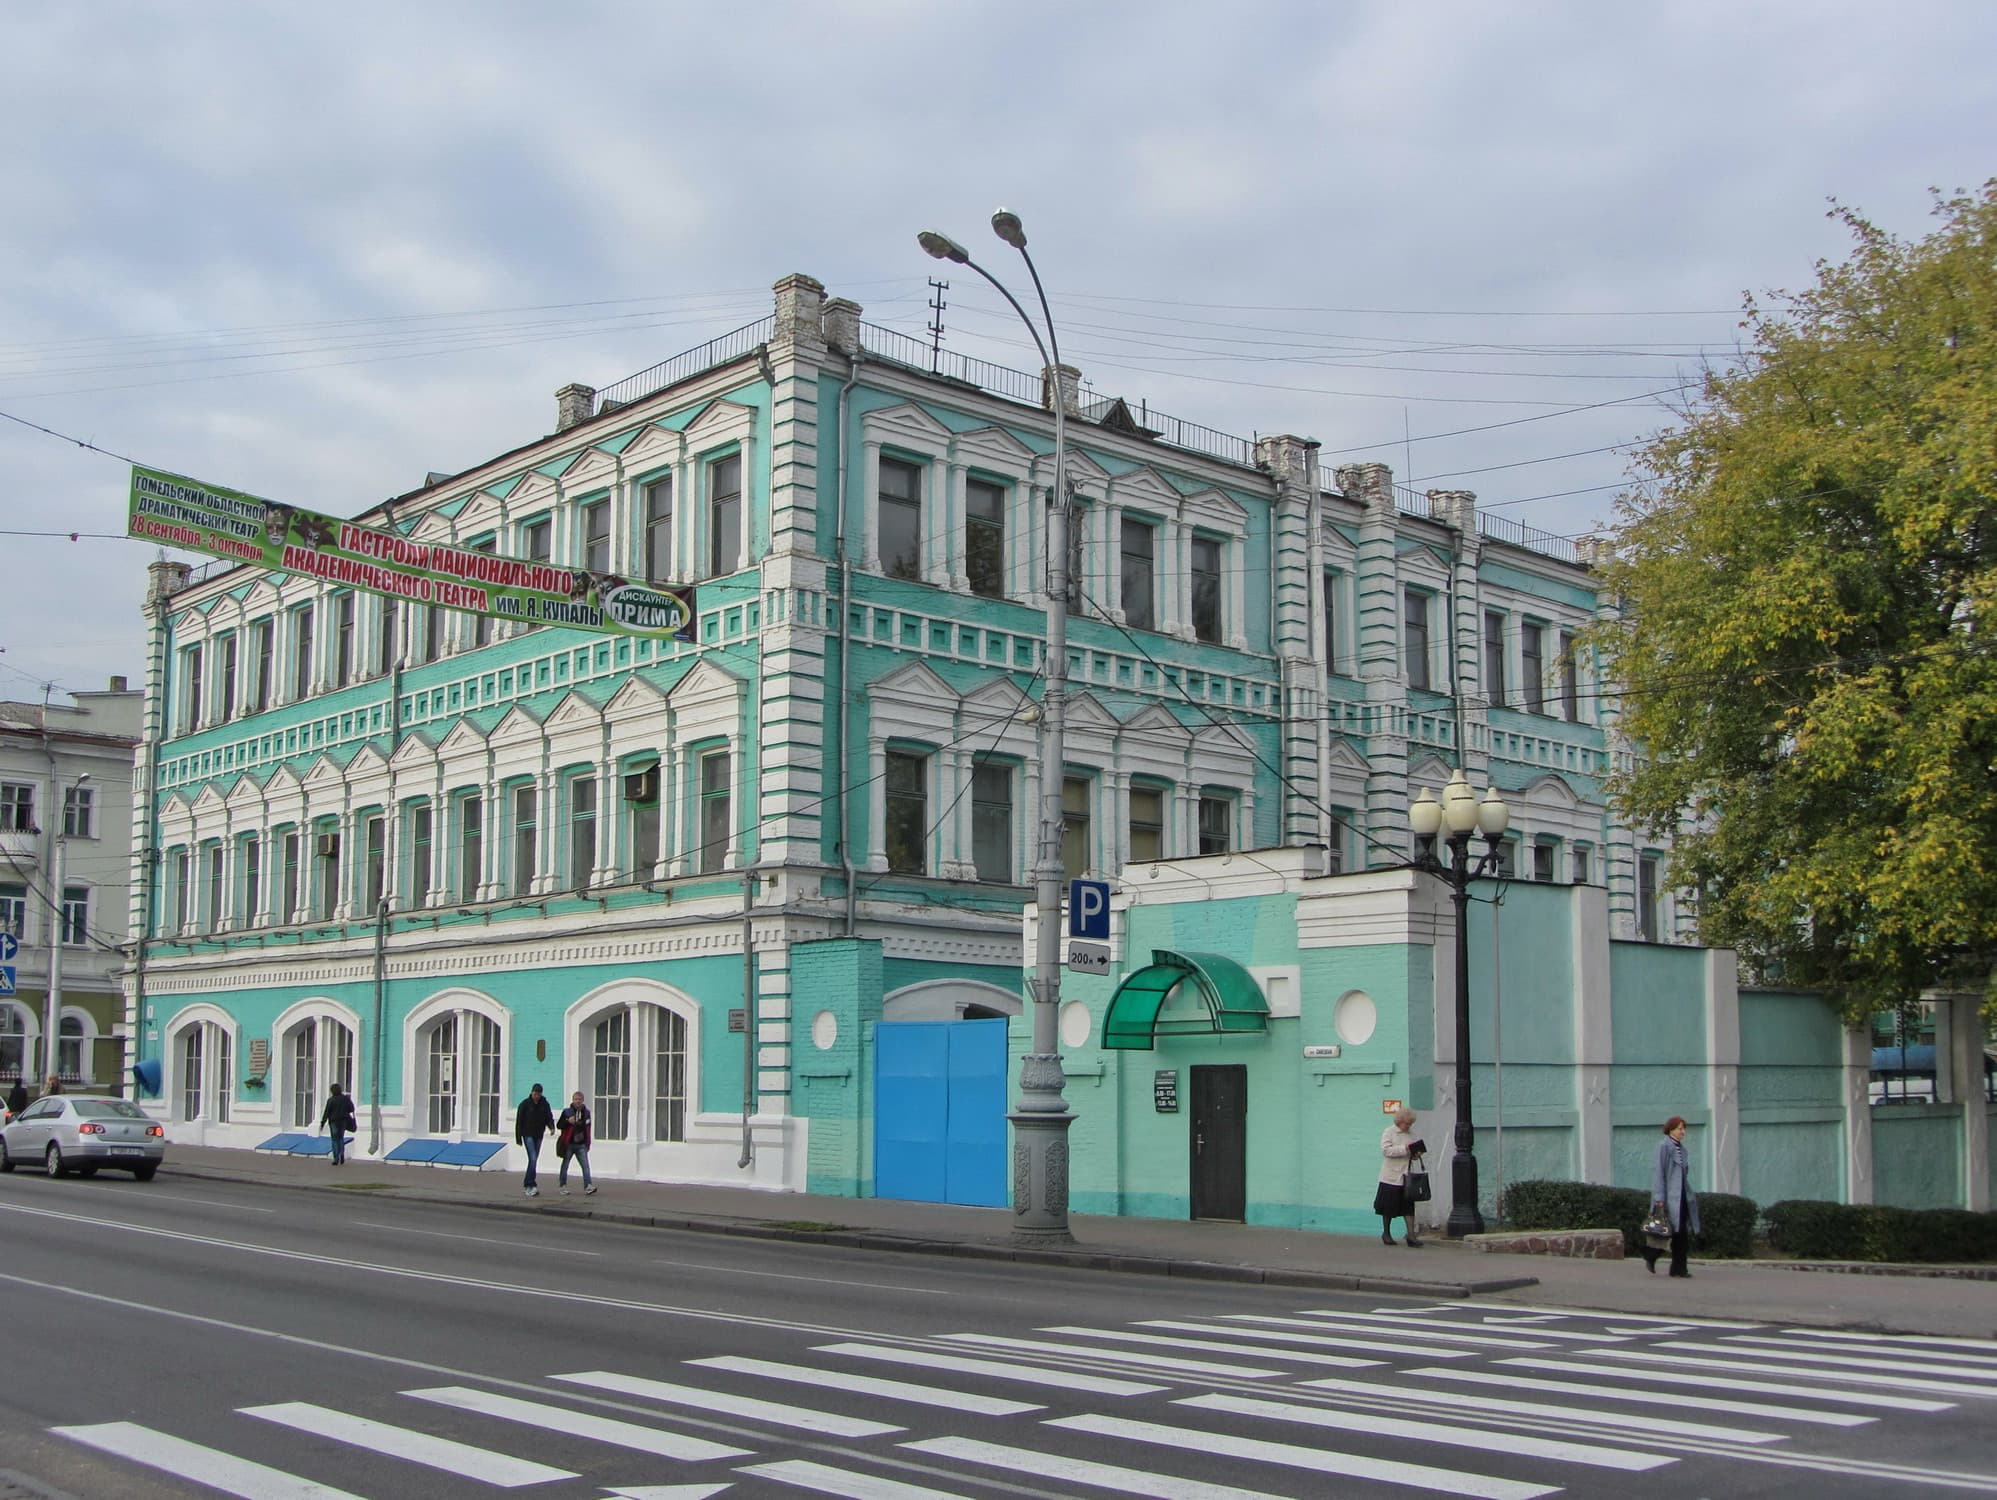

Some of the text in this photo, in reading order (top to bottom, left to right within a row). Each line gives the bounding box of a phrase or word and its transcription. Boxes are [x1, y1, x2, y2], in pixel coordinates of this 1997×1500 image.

[135, 476, 267, 522] ГОМЕЛЬСКИЙ ОБЛАСТНОЙ
[138, 498, 259, 539] ДРАМАТИЧЕСКИЙ ТЕАТР
[131, 514, 145, 533] 28
[147, 521, 201, 546] сентября
[209, 533, 216, 550] 3
[218, 538, 263, 561] октября
[340, 524, 572, 594] ГАСТРОЛИ НАЦИОНАЛЬНОГО
[282, 545, 604, 627] АКАДЕМИЧЕСКОГО ТЕАТРА ИМ. Я. КУПАЛЫ
[611, 602, 682, 628] ПРИМА
[1080, 885, 1103, 931] P
